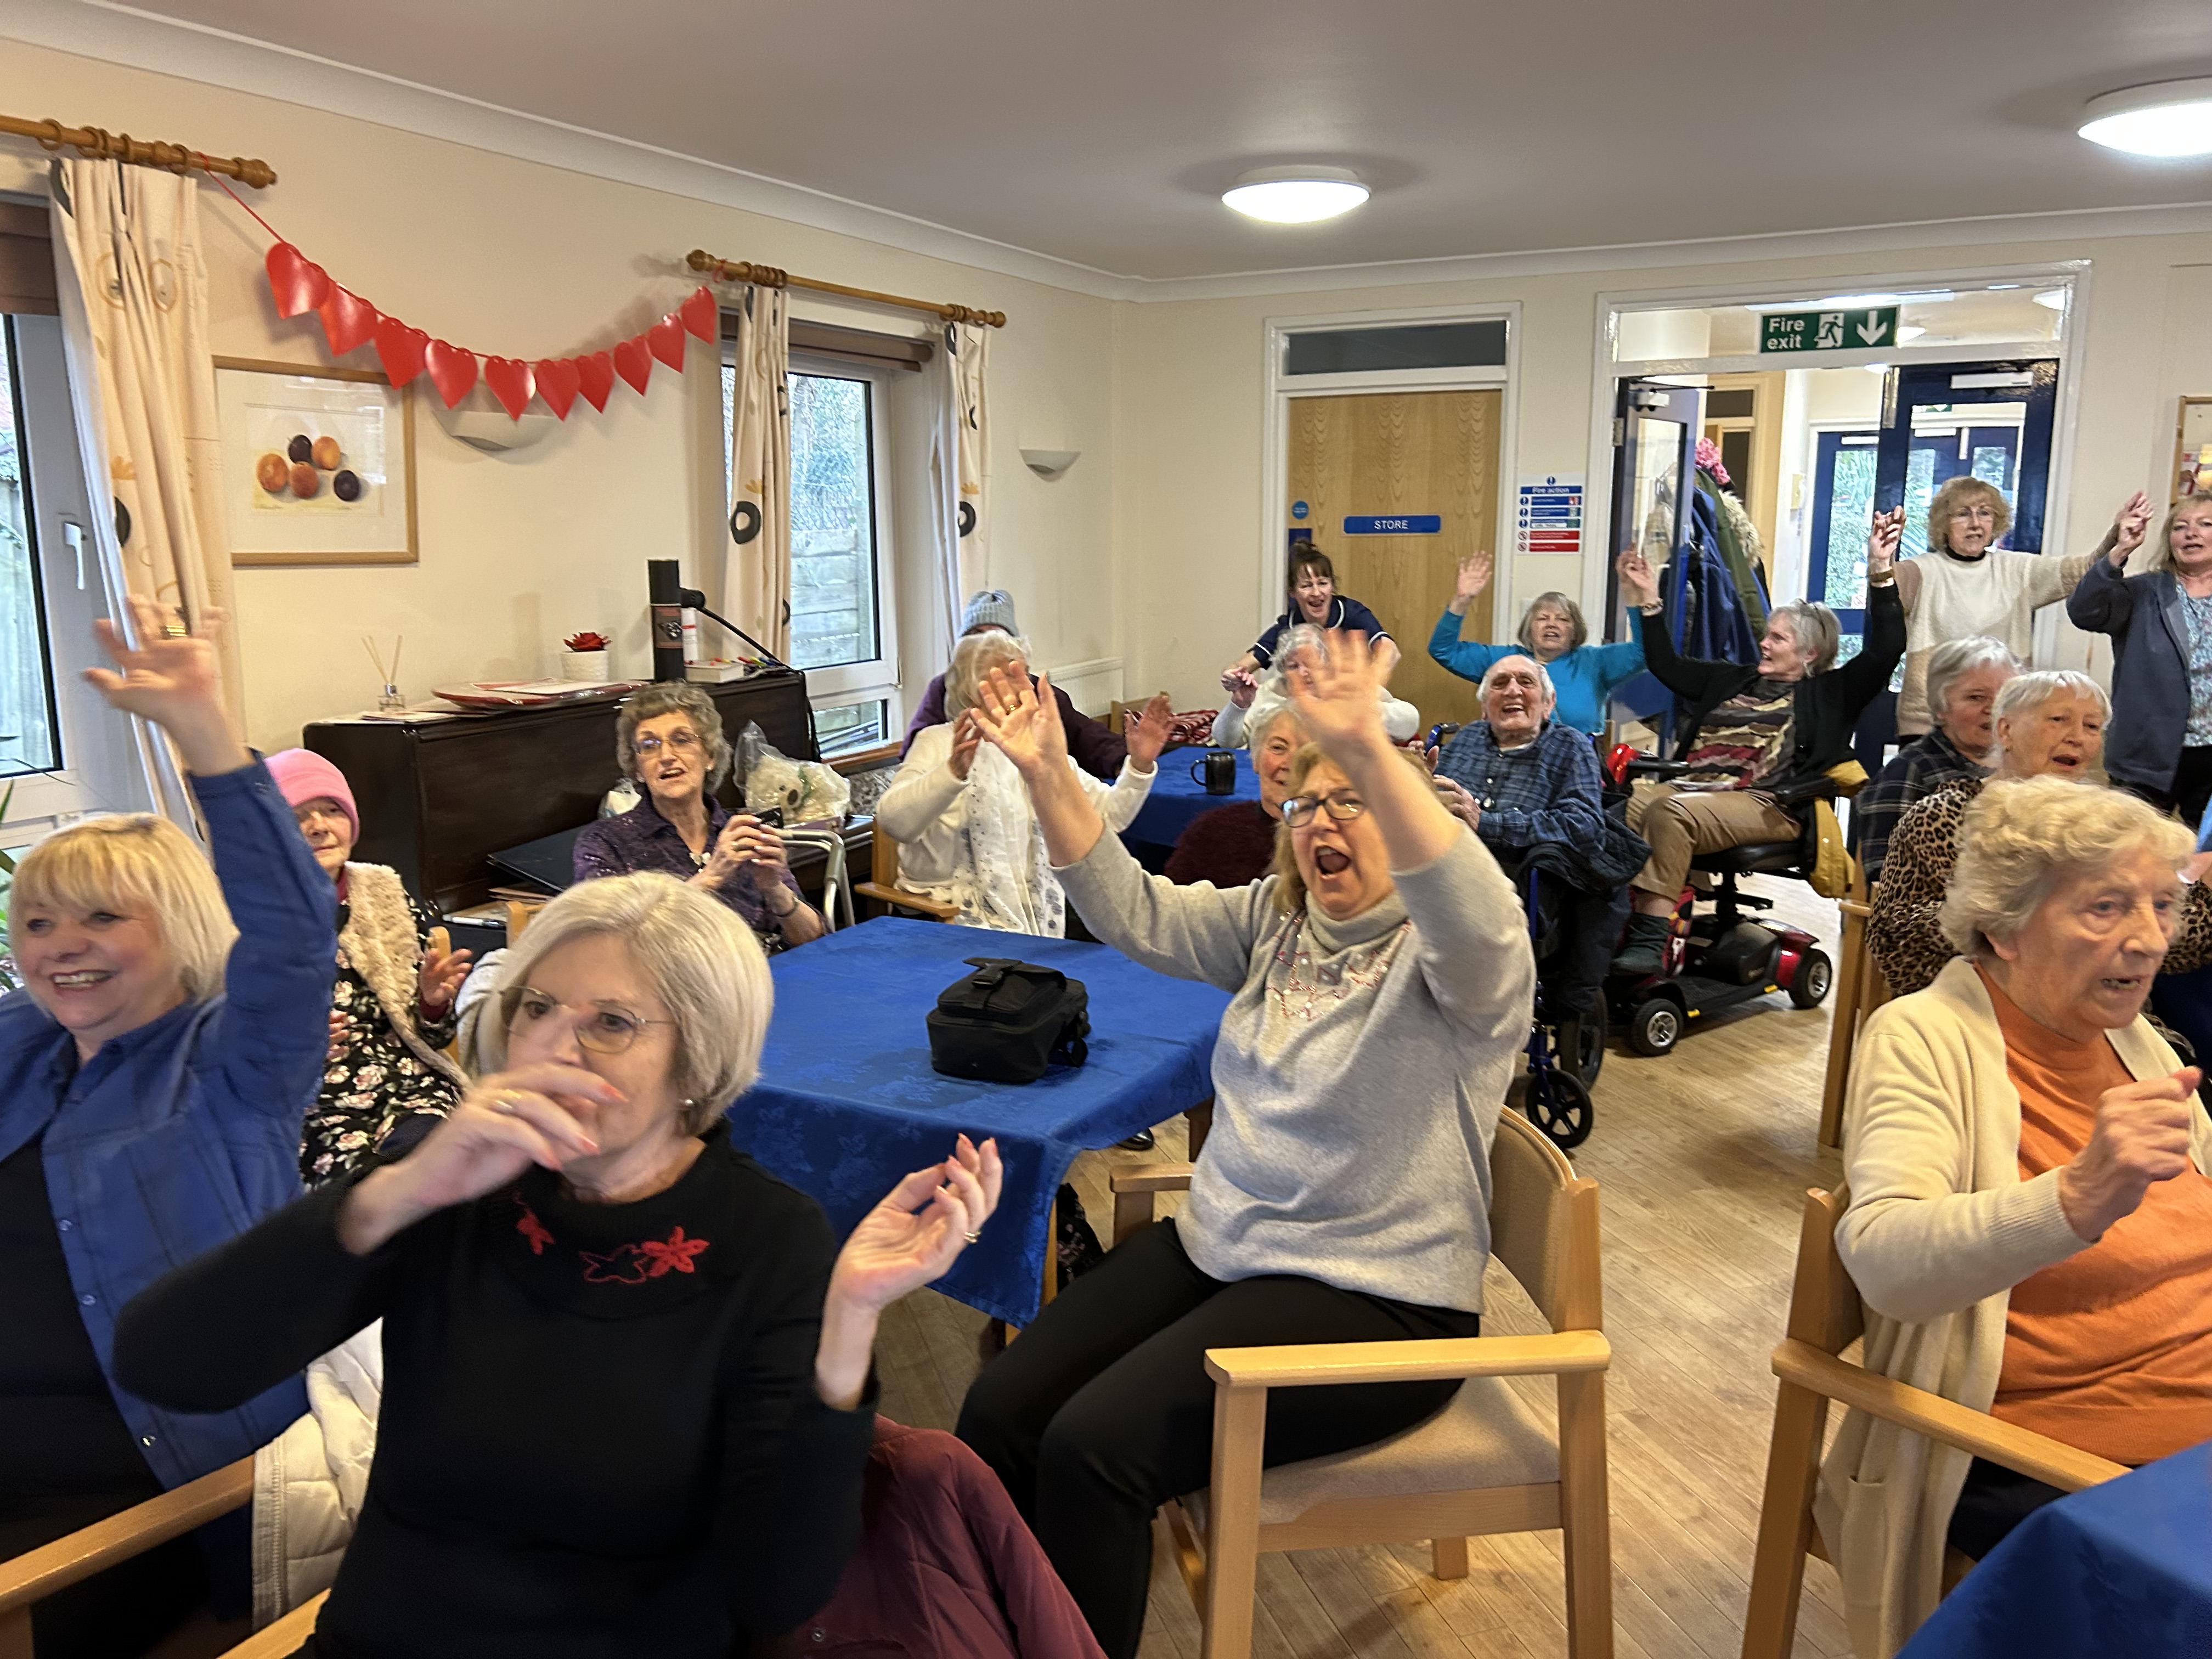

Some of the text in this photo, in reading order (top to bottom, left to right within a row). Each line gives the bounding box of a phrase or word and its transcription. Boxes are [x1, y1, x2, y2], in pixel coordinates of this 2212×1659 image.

[1768, 317, 1805, 333] Fire
[1767, 334, 1802, 350] exit
[1374, 520, 1409, 530] STORE
